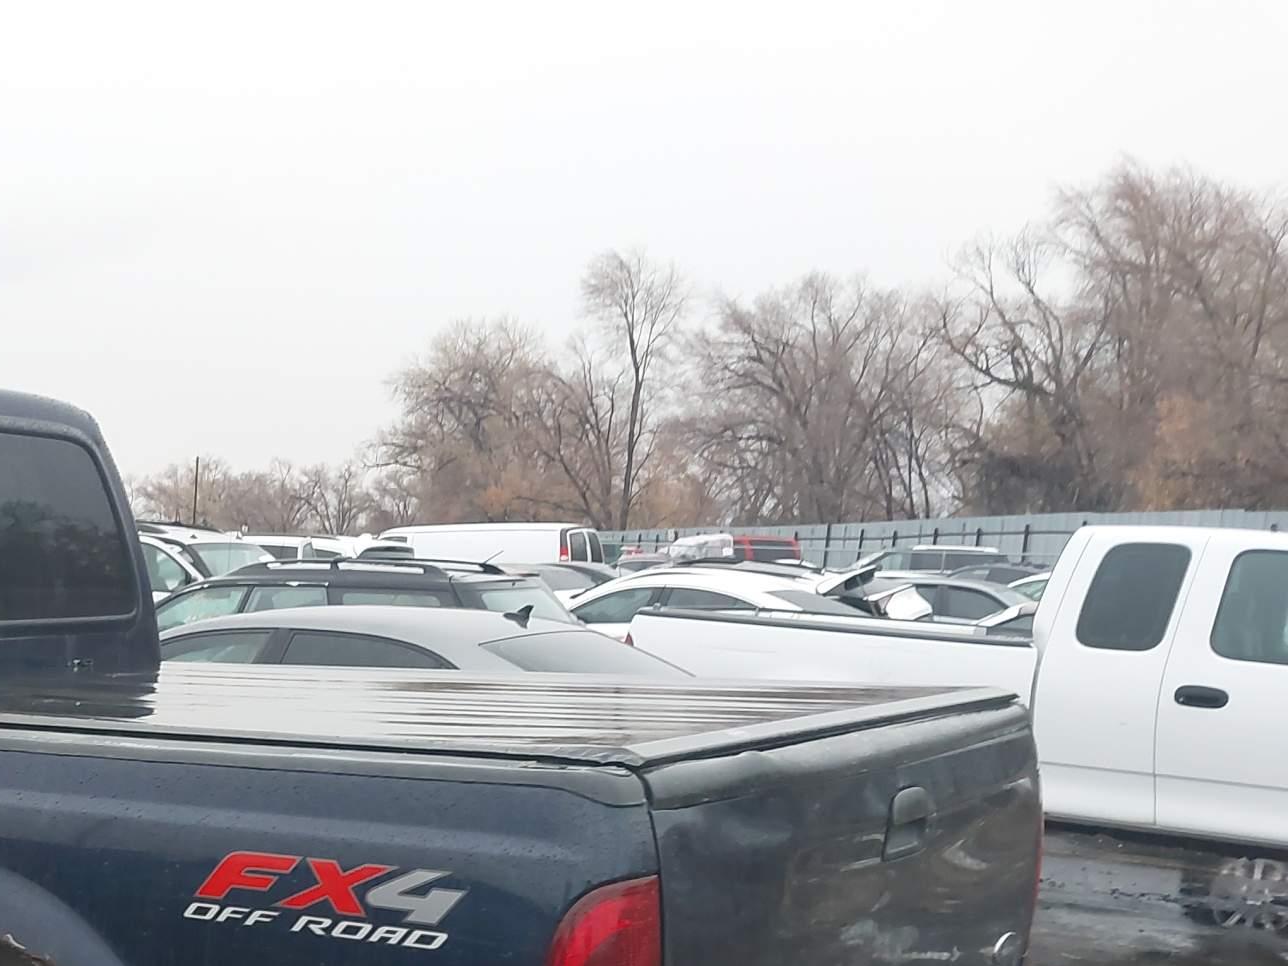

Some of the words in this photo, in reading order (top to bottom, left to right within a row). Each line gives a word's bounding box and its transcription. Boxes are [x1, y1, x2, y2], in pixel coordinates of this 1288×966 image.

[193, 850, 469, 926] FX4
[183, 902, 280, 926] OFF
[290, 915, 449, 950] ROAD
